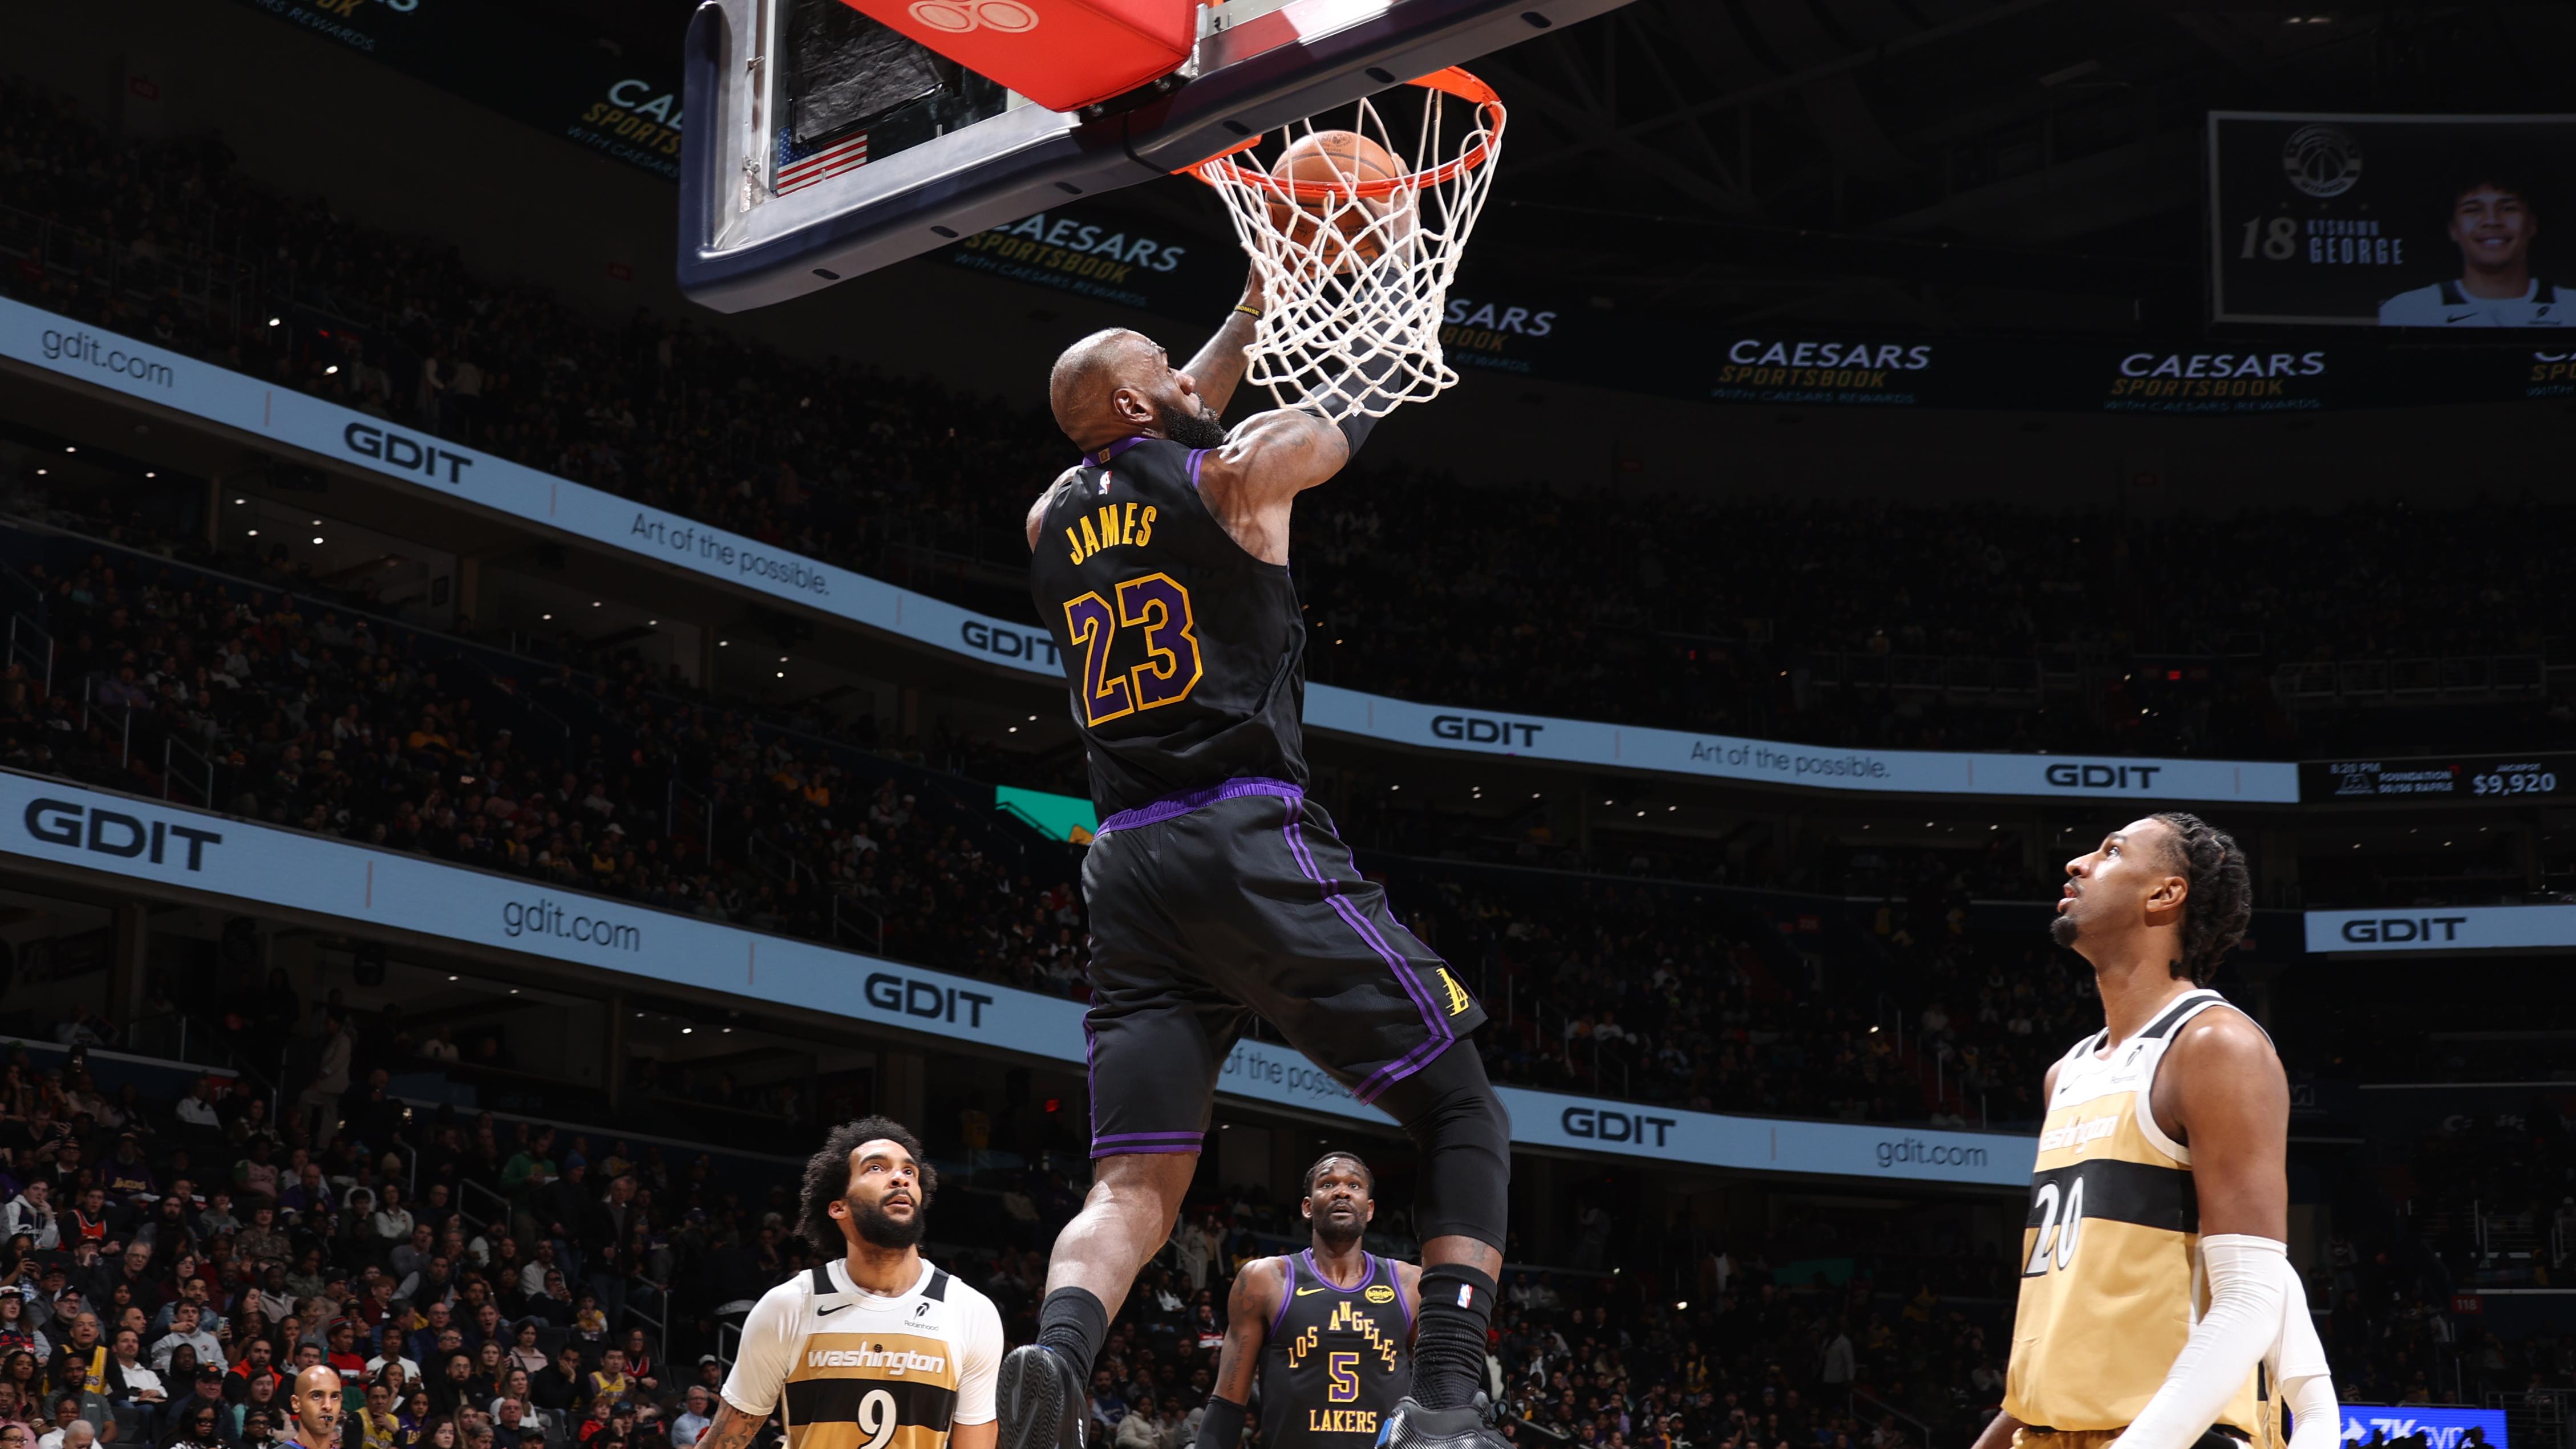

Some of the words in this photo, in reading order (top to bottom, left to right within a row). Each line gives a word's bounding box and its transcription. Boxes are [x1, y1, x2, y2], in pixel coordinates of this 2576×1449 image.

[582, 102, 681, 160] SPORTS
[964, 230, 1133, 284] SPORTSBOOK
[991, 213, 1186, 273] AESARS
[2240, 214, 2298, 261] 18
[2310, 237, 2404, 265] GEORGE
[1234, 305, 1260, 316] ROMISE
[1443, 297, 1558, 337] SARS
[42, 330, 174, 389] gdit.com
[1728, 339, 1933, 371] CAESARS
[2119, 350, 2327, 379] CAESARS
[1719, 364, 1888, 388] SPORTSBOOK
[2109, 378, 2285, 397] SPORTSBOOK
[345, 423, 473, 485] GDIT
[1066, 502, 1157, 566] JAMES
[632, 514, 666, 544] Art
[670, 527, 695, 553] of
[700, 534, 734, 566] the
[741, 548, 830, 596] possible.
[962, 620, 1057, 665] GDIT
[1063, 571, 1203, 728] 23
[1432, 715, 1544, 748] GDIT
[1691, 741, 1723, 765] Art
[1730, 744, 1752, 766] of
[1756, 748, 1789, 770] the
[1797, 752, 1891, 779] possible.
[2046, 765, 2161, 789] GDIT
[2472, 773, 2557, 797] $9,920
[25, 798, 222, 872] GDIT
[503, 899, 642, 952] gdit.com
[2342, 918, 2466, 944] GDIT
[864, 972, 994, 1028] GDIT
[1249, 1052, 1283, 1084] the
[1562, 1107, 1676, 1147] GDIT
[2039, 1115, 2119, 1155] ashington
[1876, 1138, 1988, 1168] gdit.com
[2025, 1175, 2084, 1277] 20
[2457, 1299, 2477, 1310] 118
[904, 1320, 939, 1331] Robinhood
[1287, 1326, 1319, 1369] LOS
[1328, 1301, 1397, 1372] ANGELES
[808, 1341, 945, 1376] washington
[1328, 1351, 1360, 1403] 5
[857, 1386, 897, 1449] 9
[1309, 1409, 1377, 1434] LAKERS
